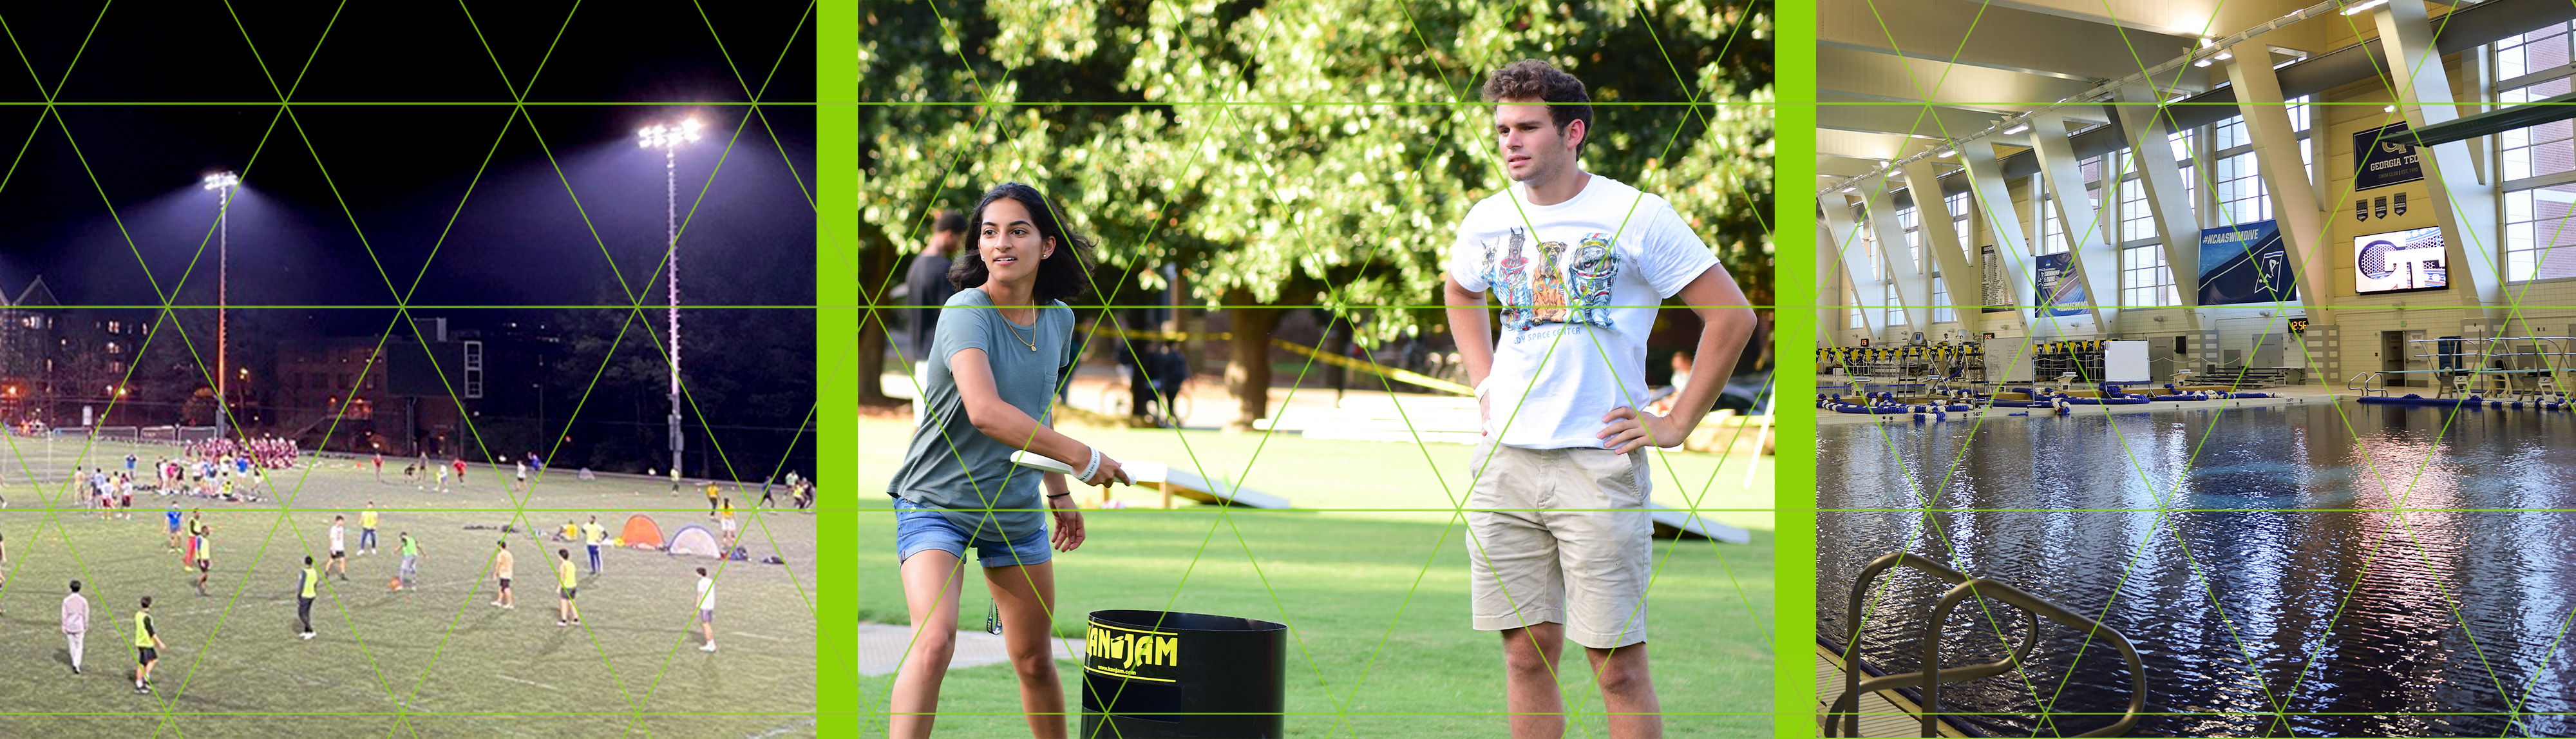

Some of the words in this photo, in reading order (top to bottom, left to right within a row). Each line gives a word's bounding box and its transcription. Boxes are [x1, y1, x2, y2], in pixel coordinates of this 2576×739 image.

[2371, 158, 2401, 171] GEORGIA
[2203, 229, 2259, 244] #NCAASWIMDIVE
[1528, 331, 1550, 341] SPACE
[1553, 327, 1580, 336] CENTER
[1123, 633, 1178, 669] JAM
[1097, 665, 1136, 675] www.kanjam.com
